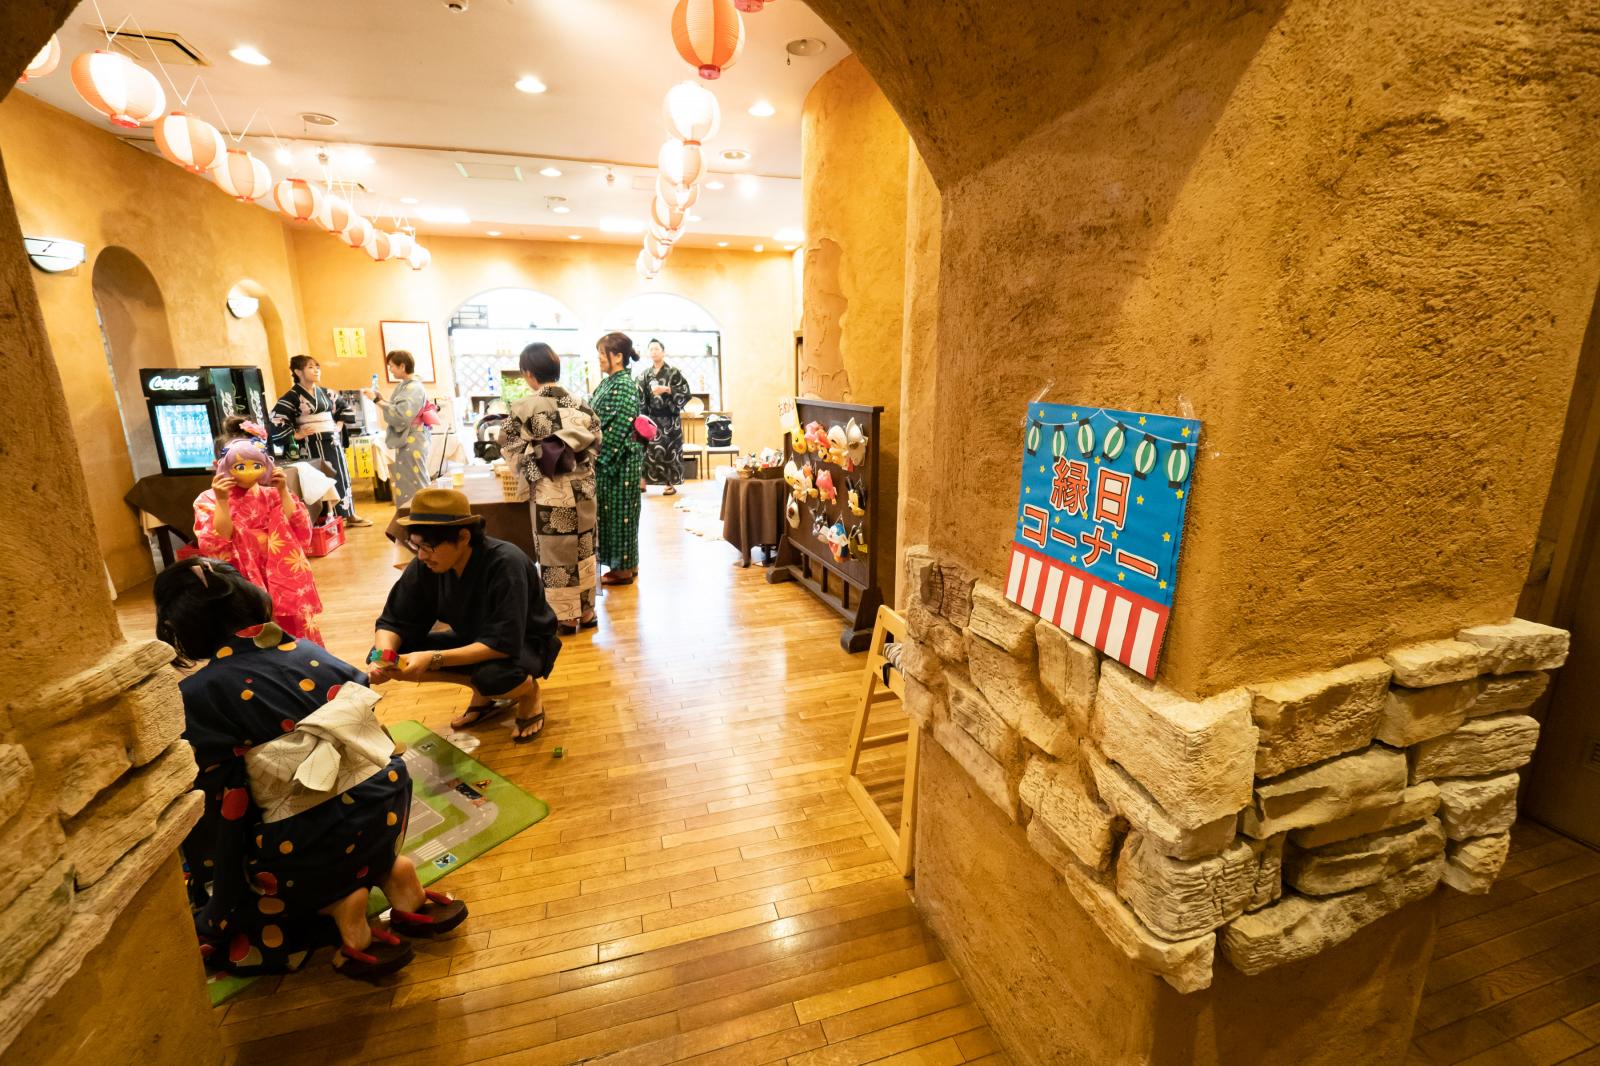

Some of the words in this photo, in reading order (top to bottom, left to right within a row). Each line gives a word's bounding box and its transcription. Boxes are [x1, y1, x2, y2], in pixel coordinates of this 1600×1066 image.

[1050, 457, 1132, 530] 縁日
[1022, 504, 1159, 579] コーナー
